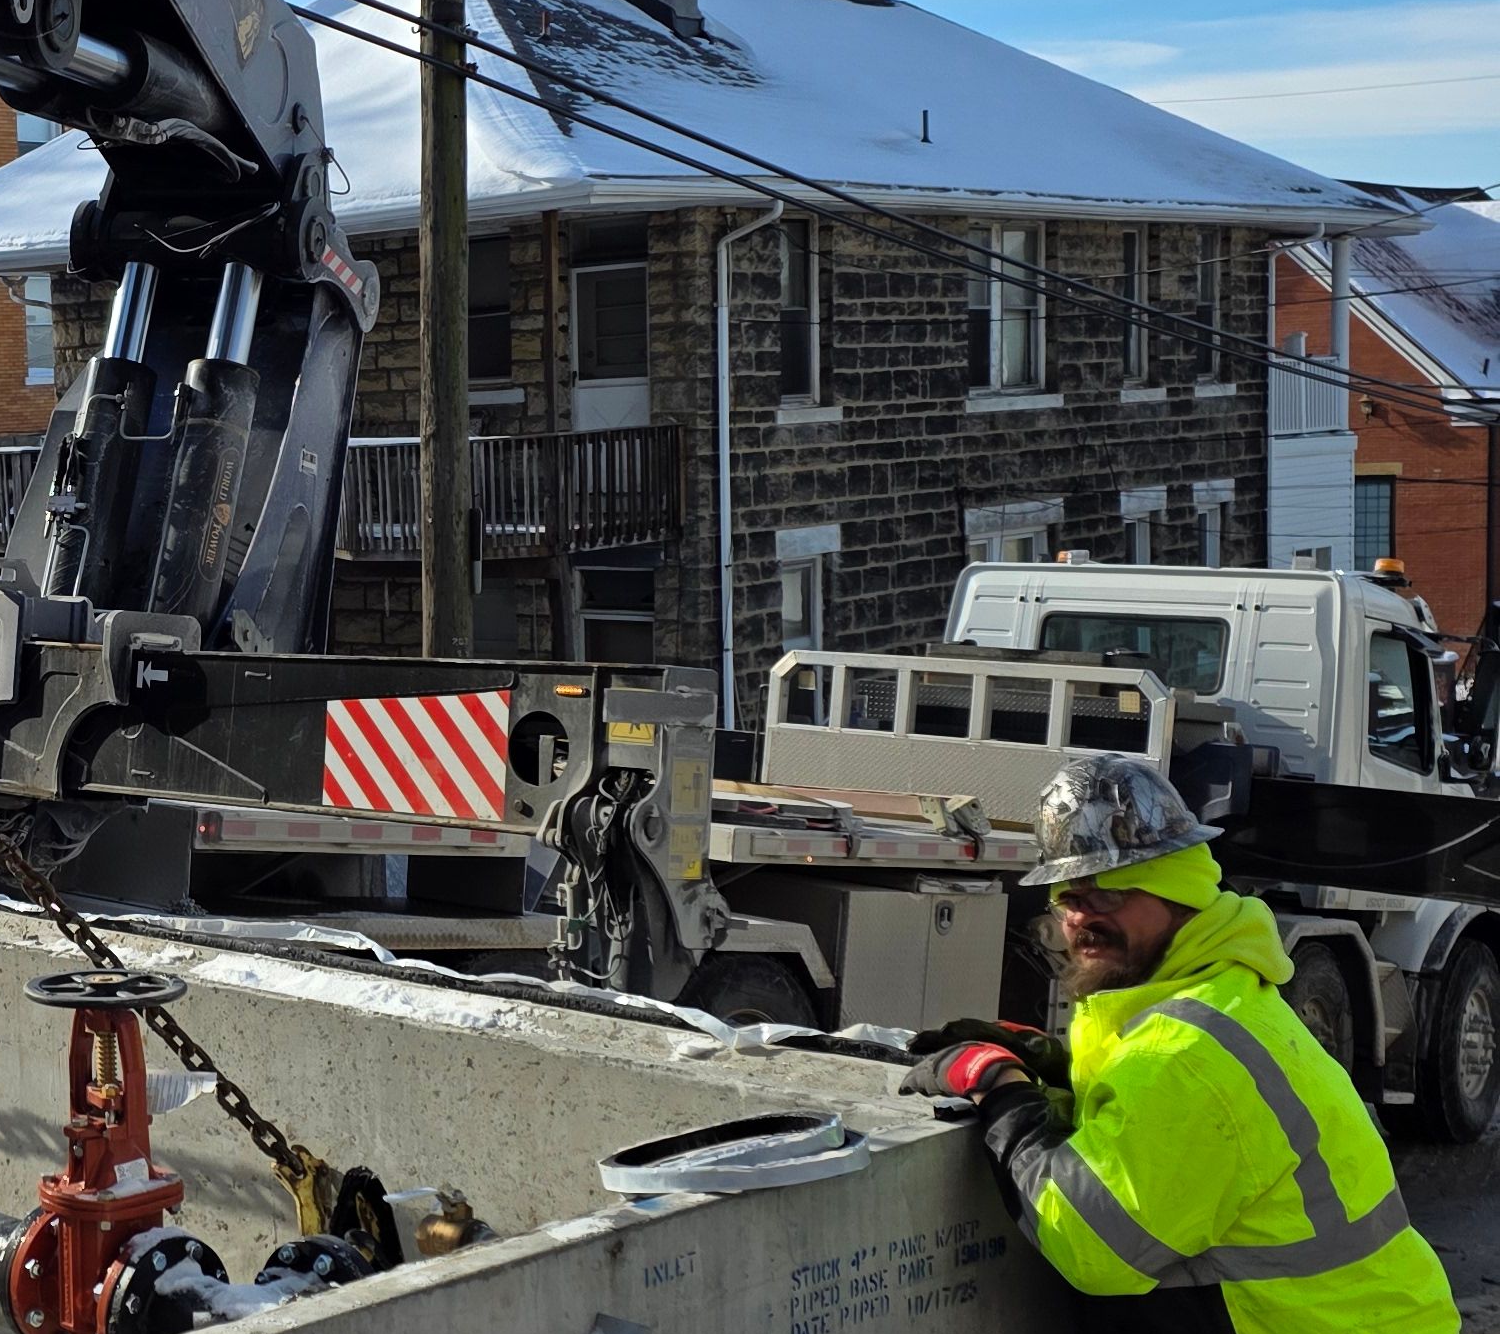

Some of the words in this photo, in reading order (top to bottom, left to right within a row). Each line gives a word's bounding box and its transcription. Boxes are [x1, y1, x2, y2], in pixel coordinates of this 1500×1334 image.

[219, 460, 235, 501] WORLD
[205, 521, 223, 566] POWER
[644, 1251, 697, 1289] INLET
[790, 1284, 841, 1318] PIPED
[850, 1268, 889, 1299] BASE
[898, 1254, 935, 1286] PART
[791, 1256, 841, 1292] STOCK
[840, 1293, 890, 1330] PIPED
